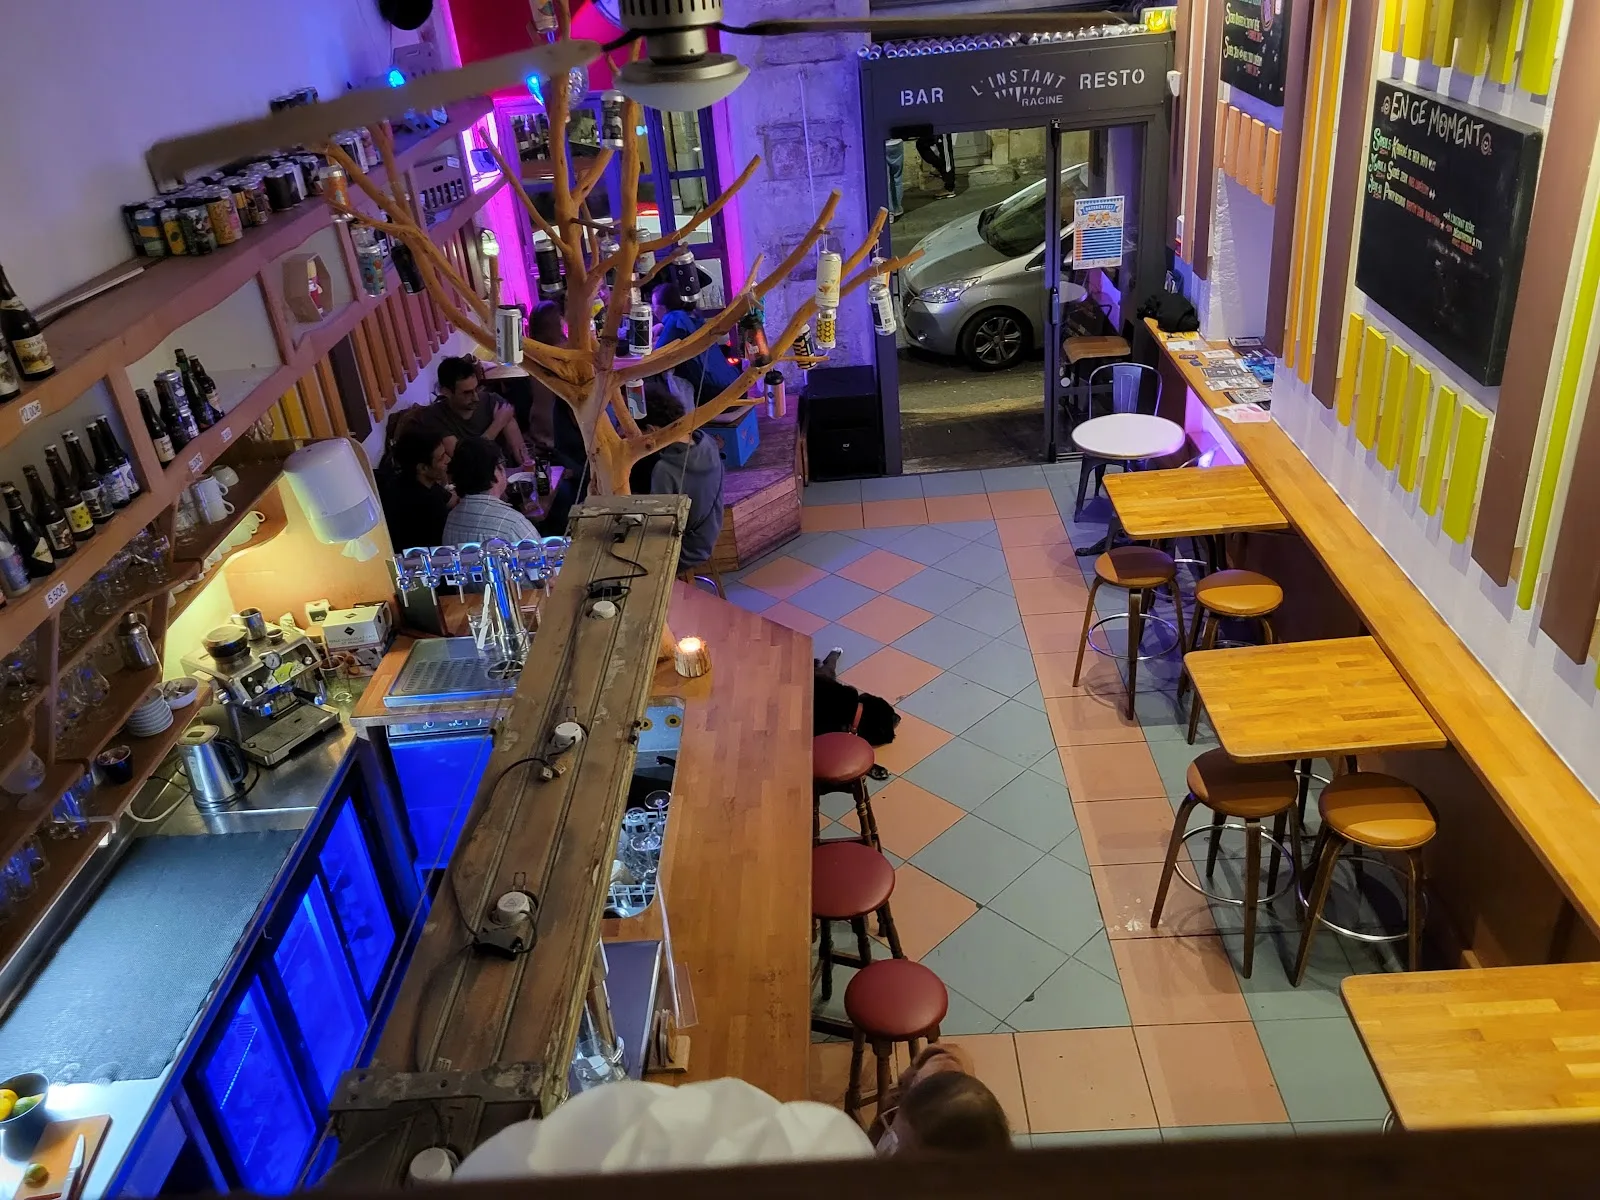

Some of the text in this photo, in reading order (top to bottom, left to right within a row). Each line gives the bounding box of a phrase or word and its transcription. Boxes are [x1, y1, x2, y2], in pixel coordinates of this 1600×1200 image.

[971, 69, 1066, 96] L'INSTANT
[1079, 68, 1145, 90] RESTO
[900, 87, 944, 106] BAR
[1021, 95, 1064, 107] RACINE
[1390, 91, 1484, 148] EN CE MOMENT
[48, 583, 66, 604] 5.50€
